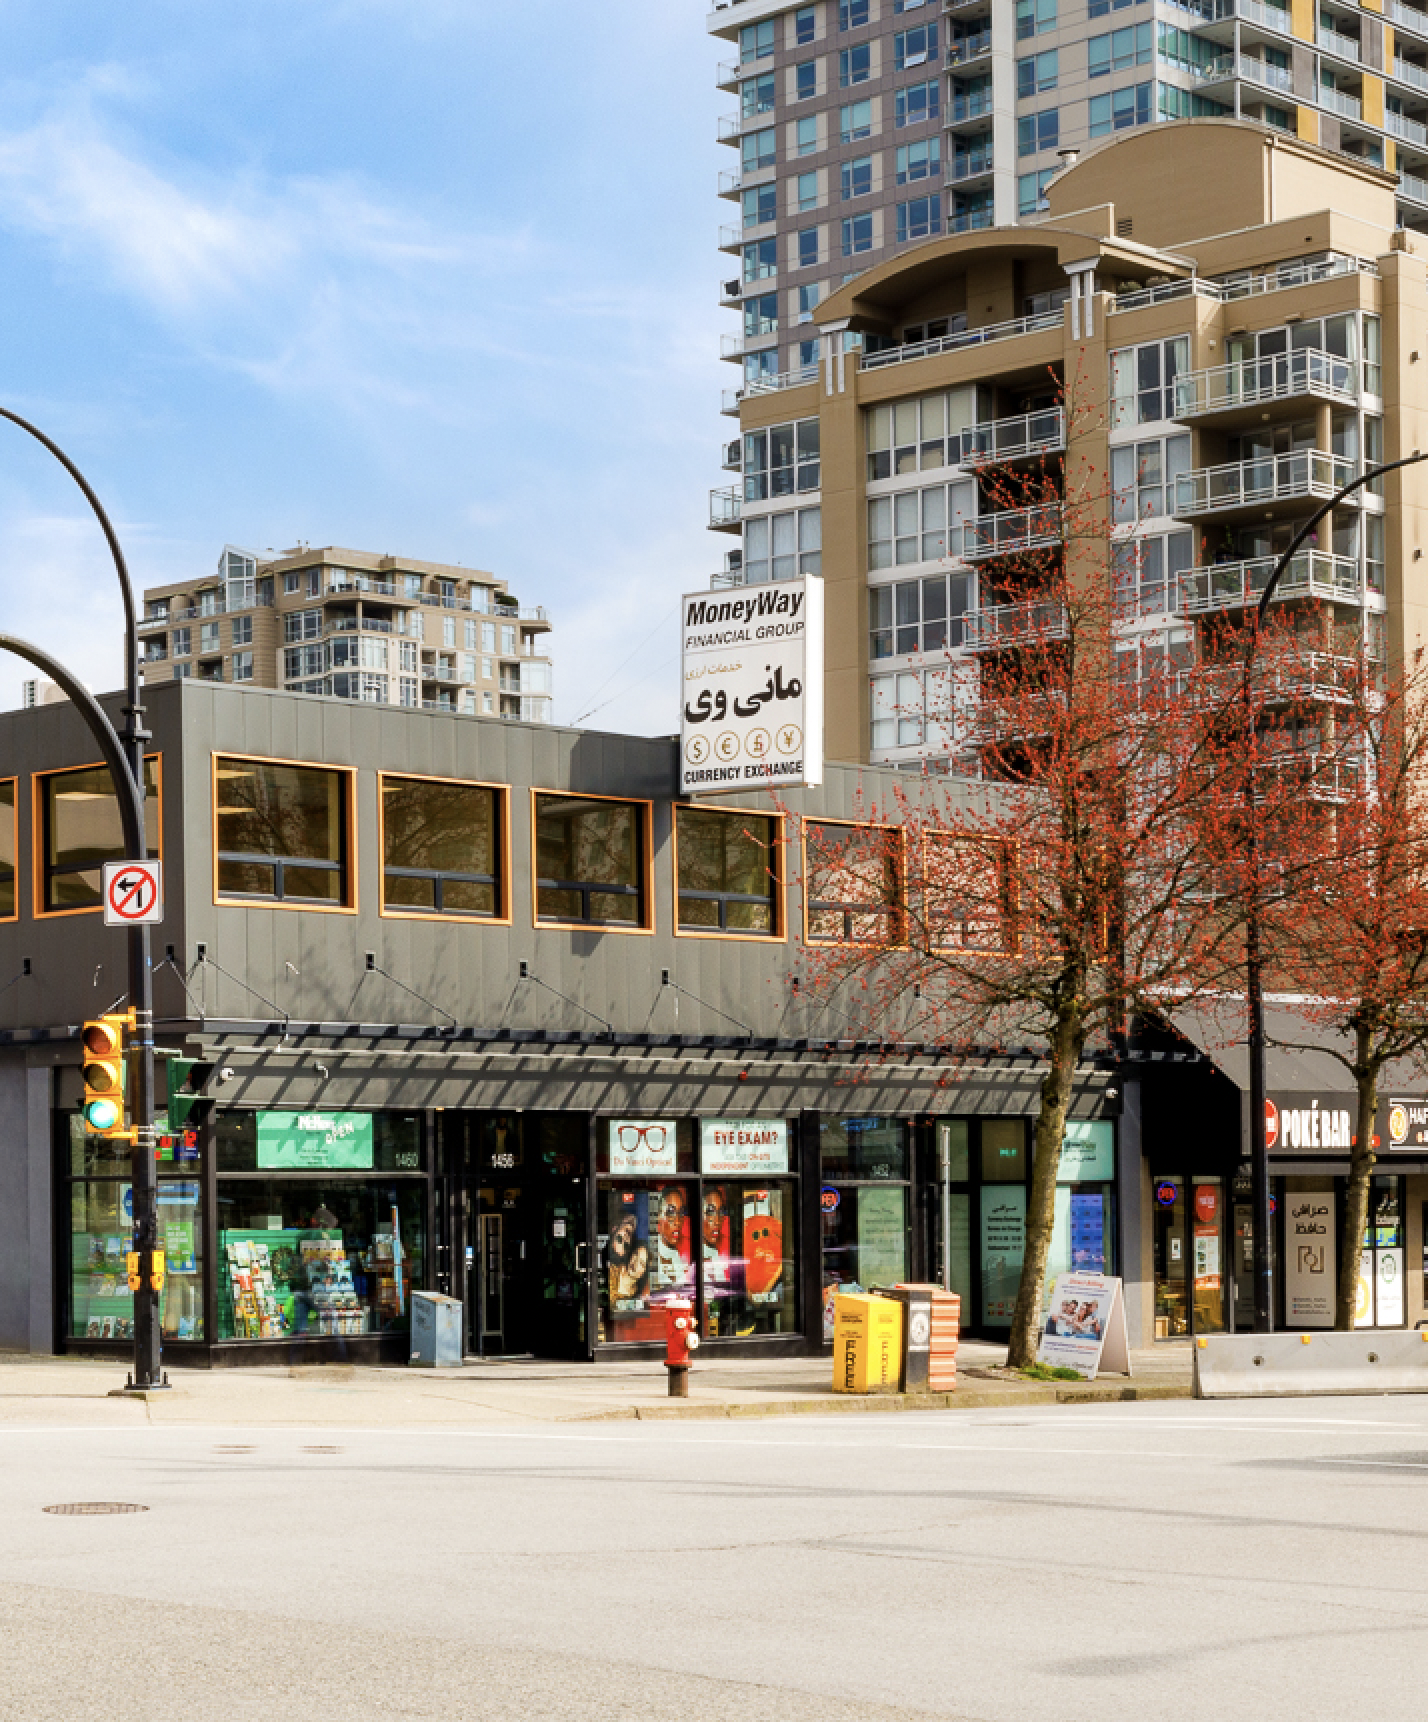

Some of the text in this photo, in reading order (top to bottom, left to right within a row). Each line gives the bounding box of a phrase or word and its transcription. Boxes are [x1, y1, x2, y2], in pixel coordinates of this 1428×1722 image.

[686, 590, 804, 626] MoneyWay
[686, 621, 804, 648] FINANCIAL GROUP
[685, 664, 802, 723] مانی وی
[685, 760, 803, 784] CURRENCY EXCHANGE
[713, 1130, 779, 1145] EYE EXAM?
[1281, 1099, 1351, 1148] POKÉ BAR
[844, 1339, 857, 1389] FREE
